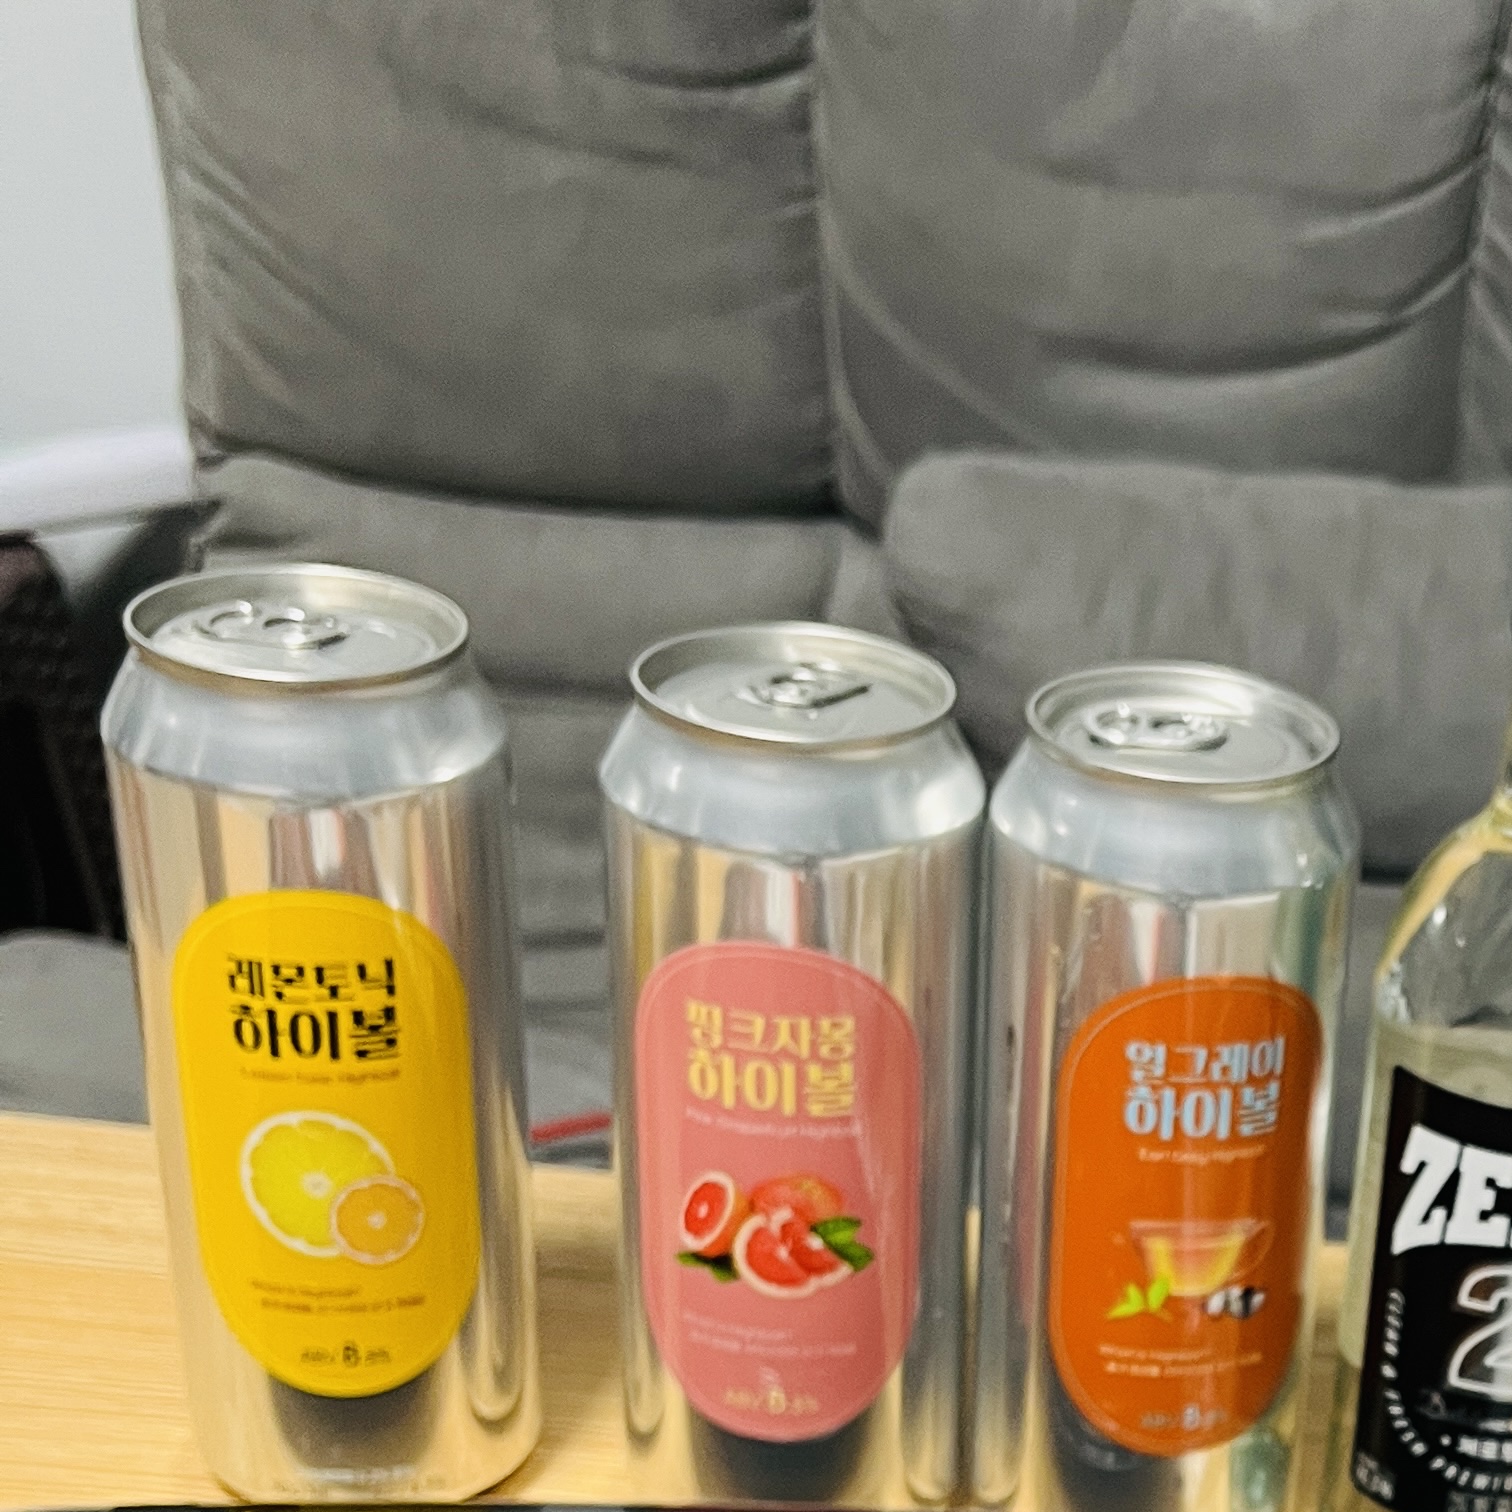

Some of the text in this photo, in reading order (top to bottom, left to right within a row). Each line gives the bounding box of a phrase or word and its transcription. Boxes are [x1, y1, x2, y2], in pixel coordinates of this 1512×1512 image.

[226, 951, 397, 1006] 레몬토닉
[232, 1002, 401, 1062] 하이볼
[684, 996, 857, 1061] 핑크자몽
[686, 1047, 857, 1117] 하이볼
[1124, 1035, 1287, 1084] 얼그레이
[1123, 1082, 1280, 1141] 하이볼
